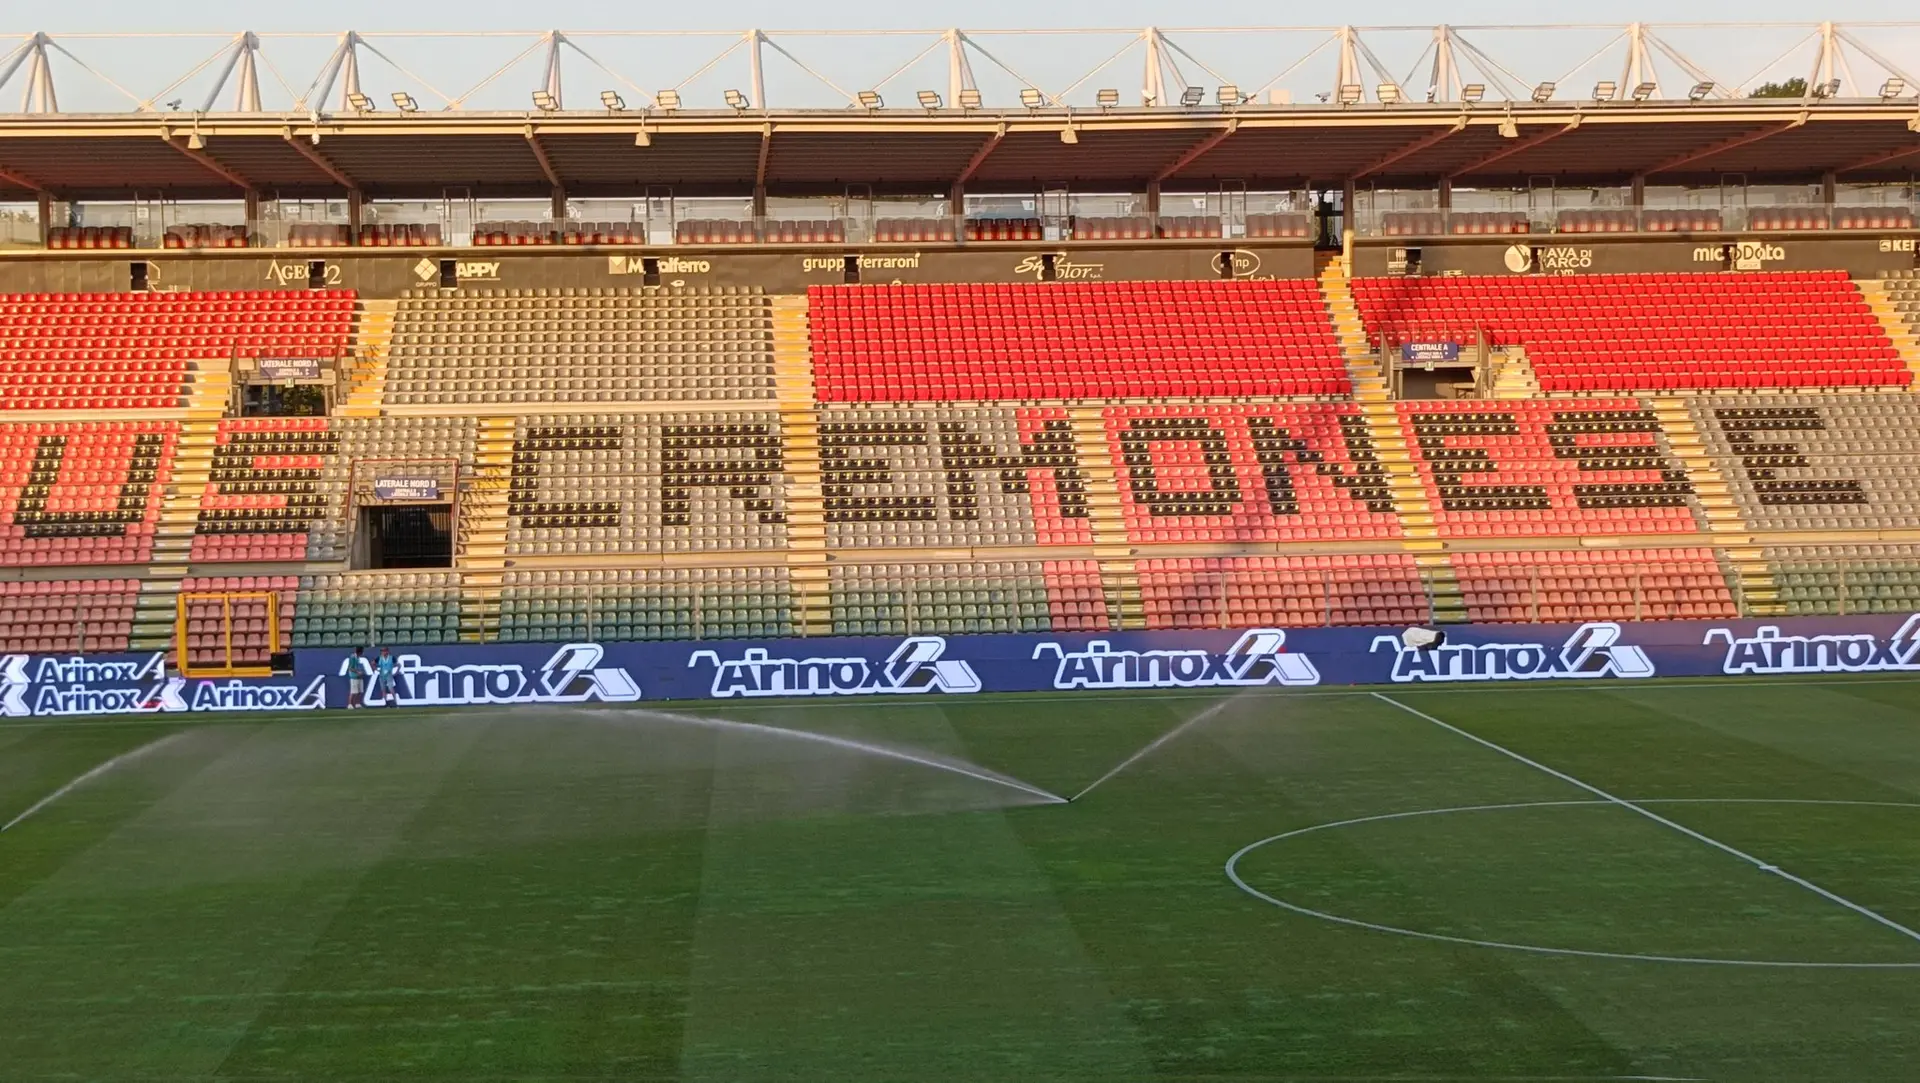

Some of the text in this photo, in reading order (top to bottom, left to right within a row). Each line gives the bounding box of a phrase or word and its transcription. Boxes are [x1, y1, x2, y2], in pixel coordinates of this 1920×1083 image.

[802, 252, 920, 272] grupp ferraroni
[1580, 250, 1592, 258] DI
[455, 262, 500, 278] APPY
[1411, 343, 1449, 351] CENTRALE A
[260, 360, 318, 368] LATERALE NORD A
[375, 479, 437, 488] LATERALE NORD B
[1723, 625, 1902, 674] Arinox
[34, 657, 138, 683] Arinox
[711, 648, 895, 697] Arinox
[1054, 640, 1238, 688] Arinox
[33, 685, 141, 716] Arinox
[192, 680, 300, 711] Arinox
